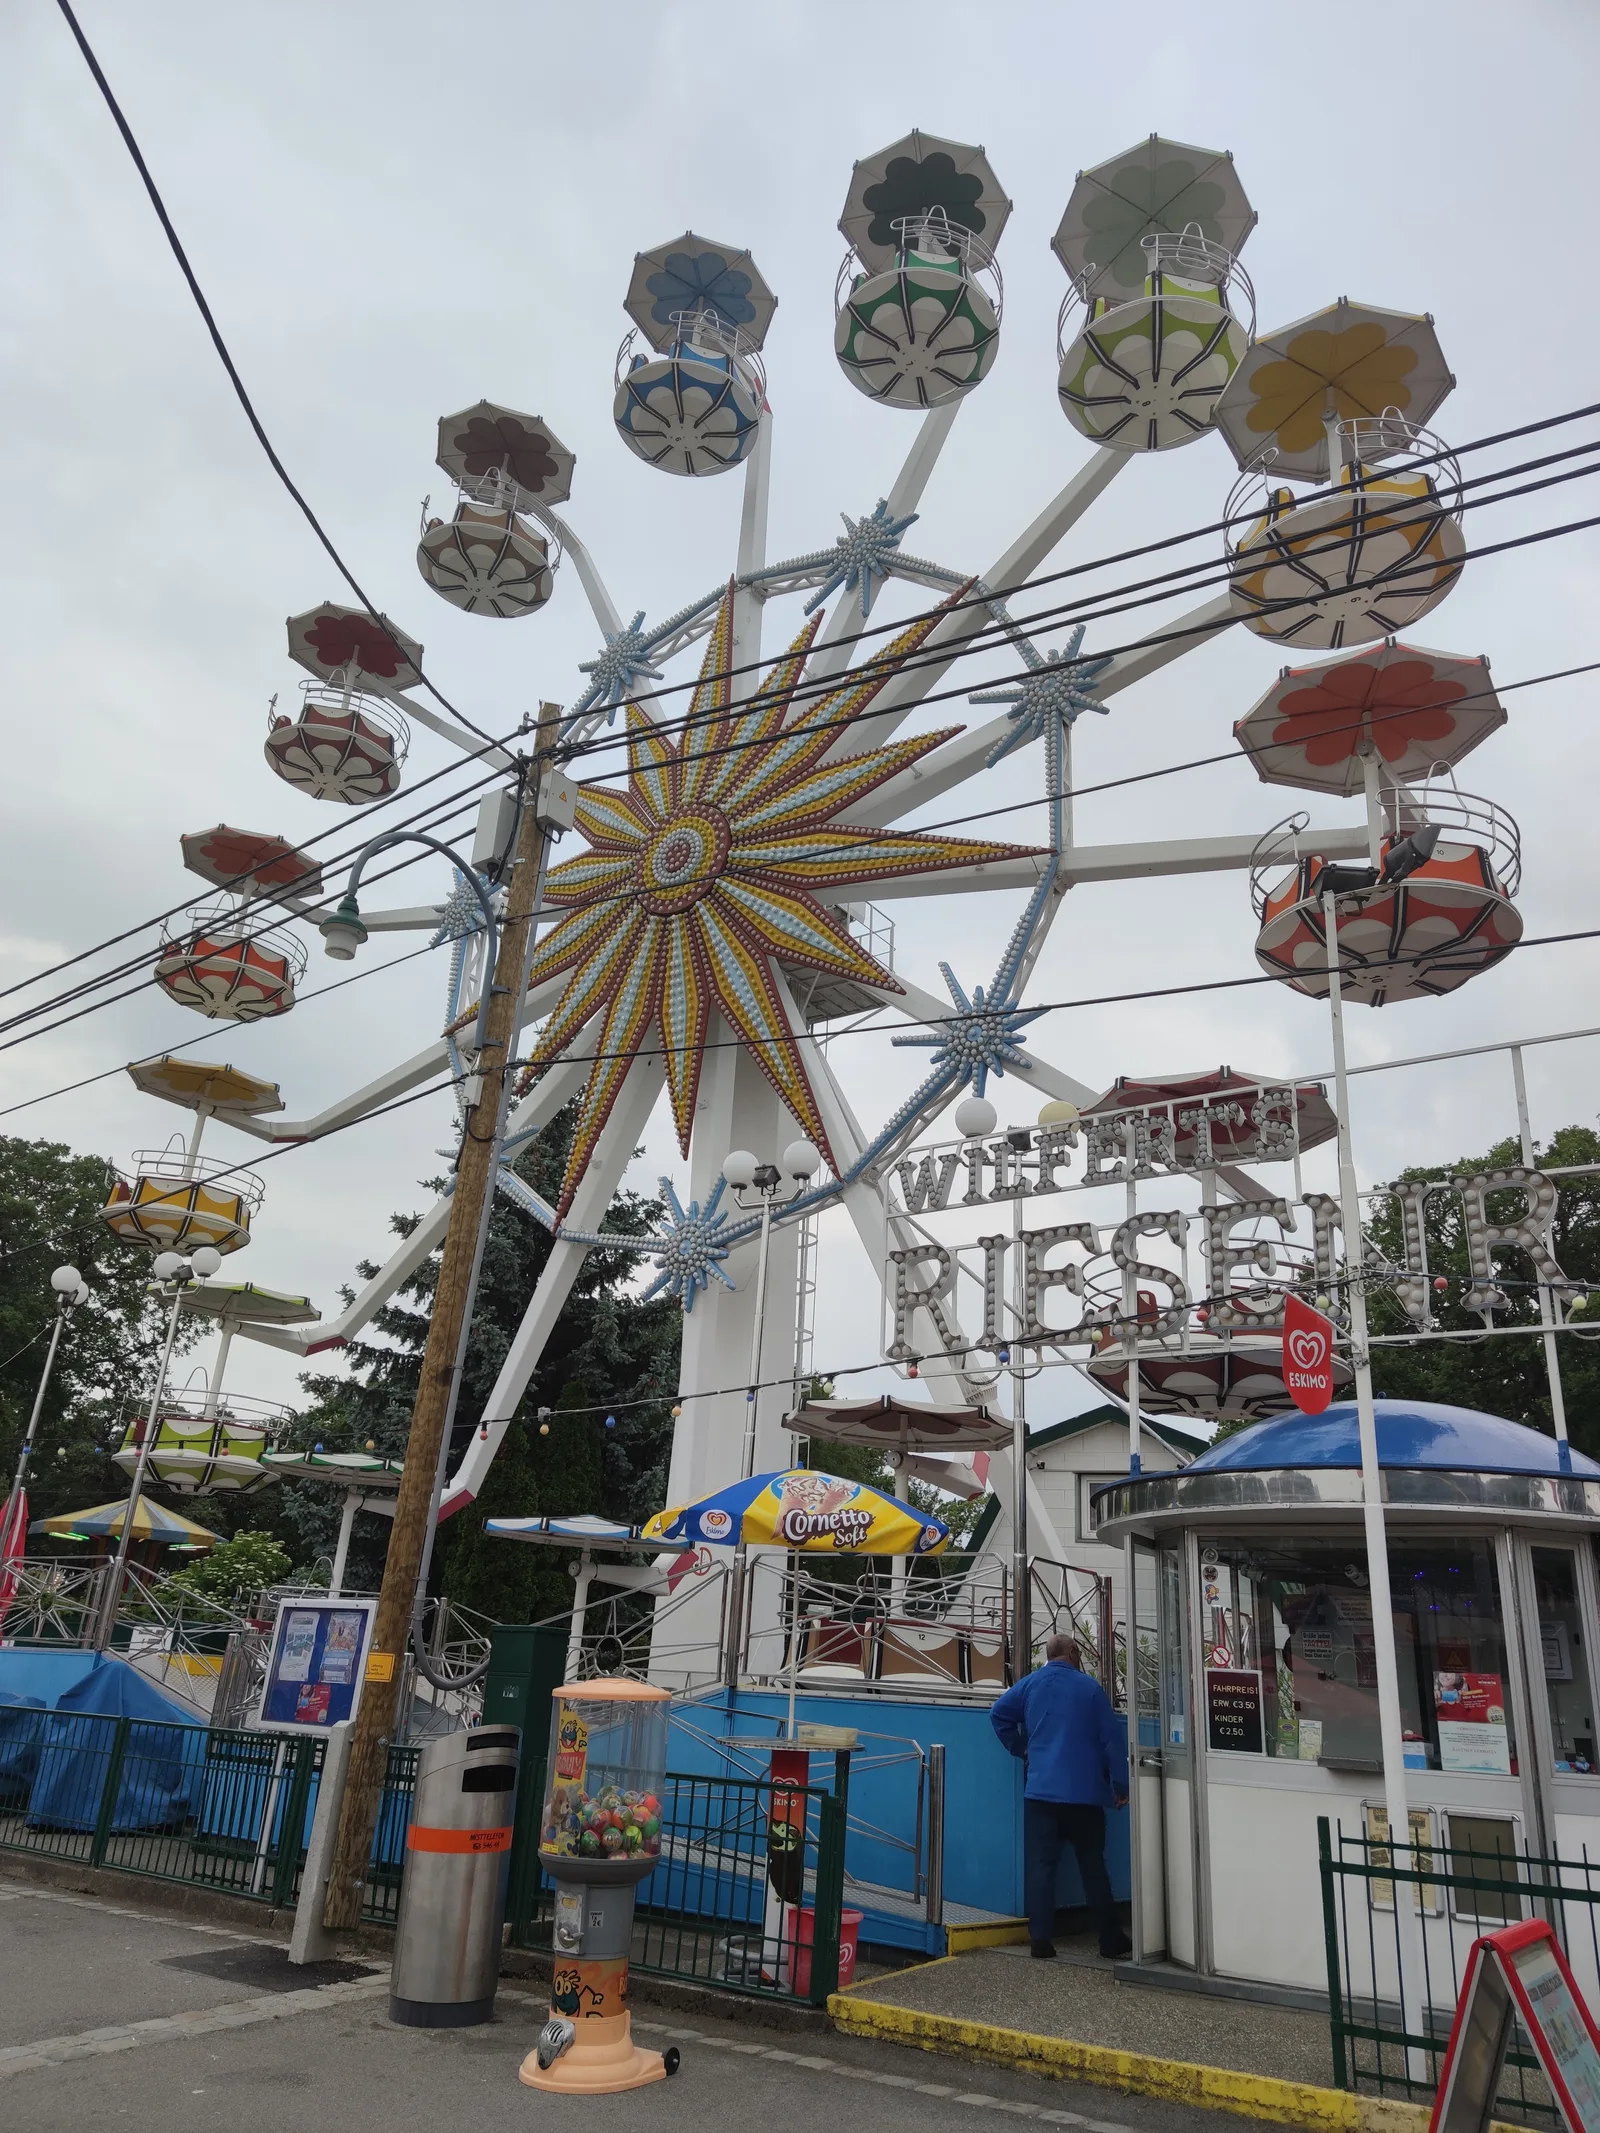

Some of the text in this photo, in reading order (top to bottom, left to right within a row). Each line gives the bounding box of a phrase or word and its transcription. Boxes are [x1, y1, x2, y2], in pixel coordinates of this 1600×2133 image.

[785, 1509, 870, 1541] Cornetto
[835, 1525, 867, 1547] Soft
[1214, 1714, 1244, 1724] KINDER
